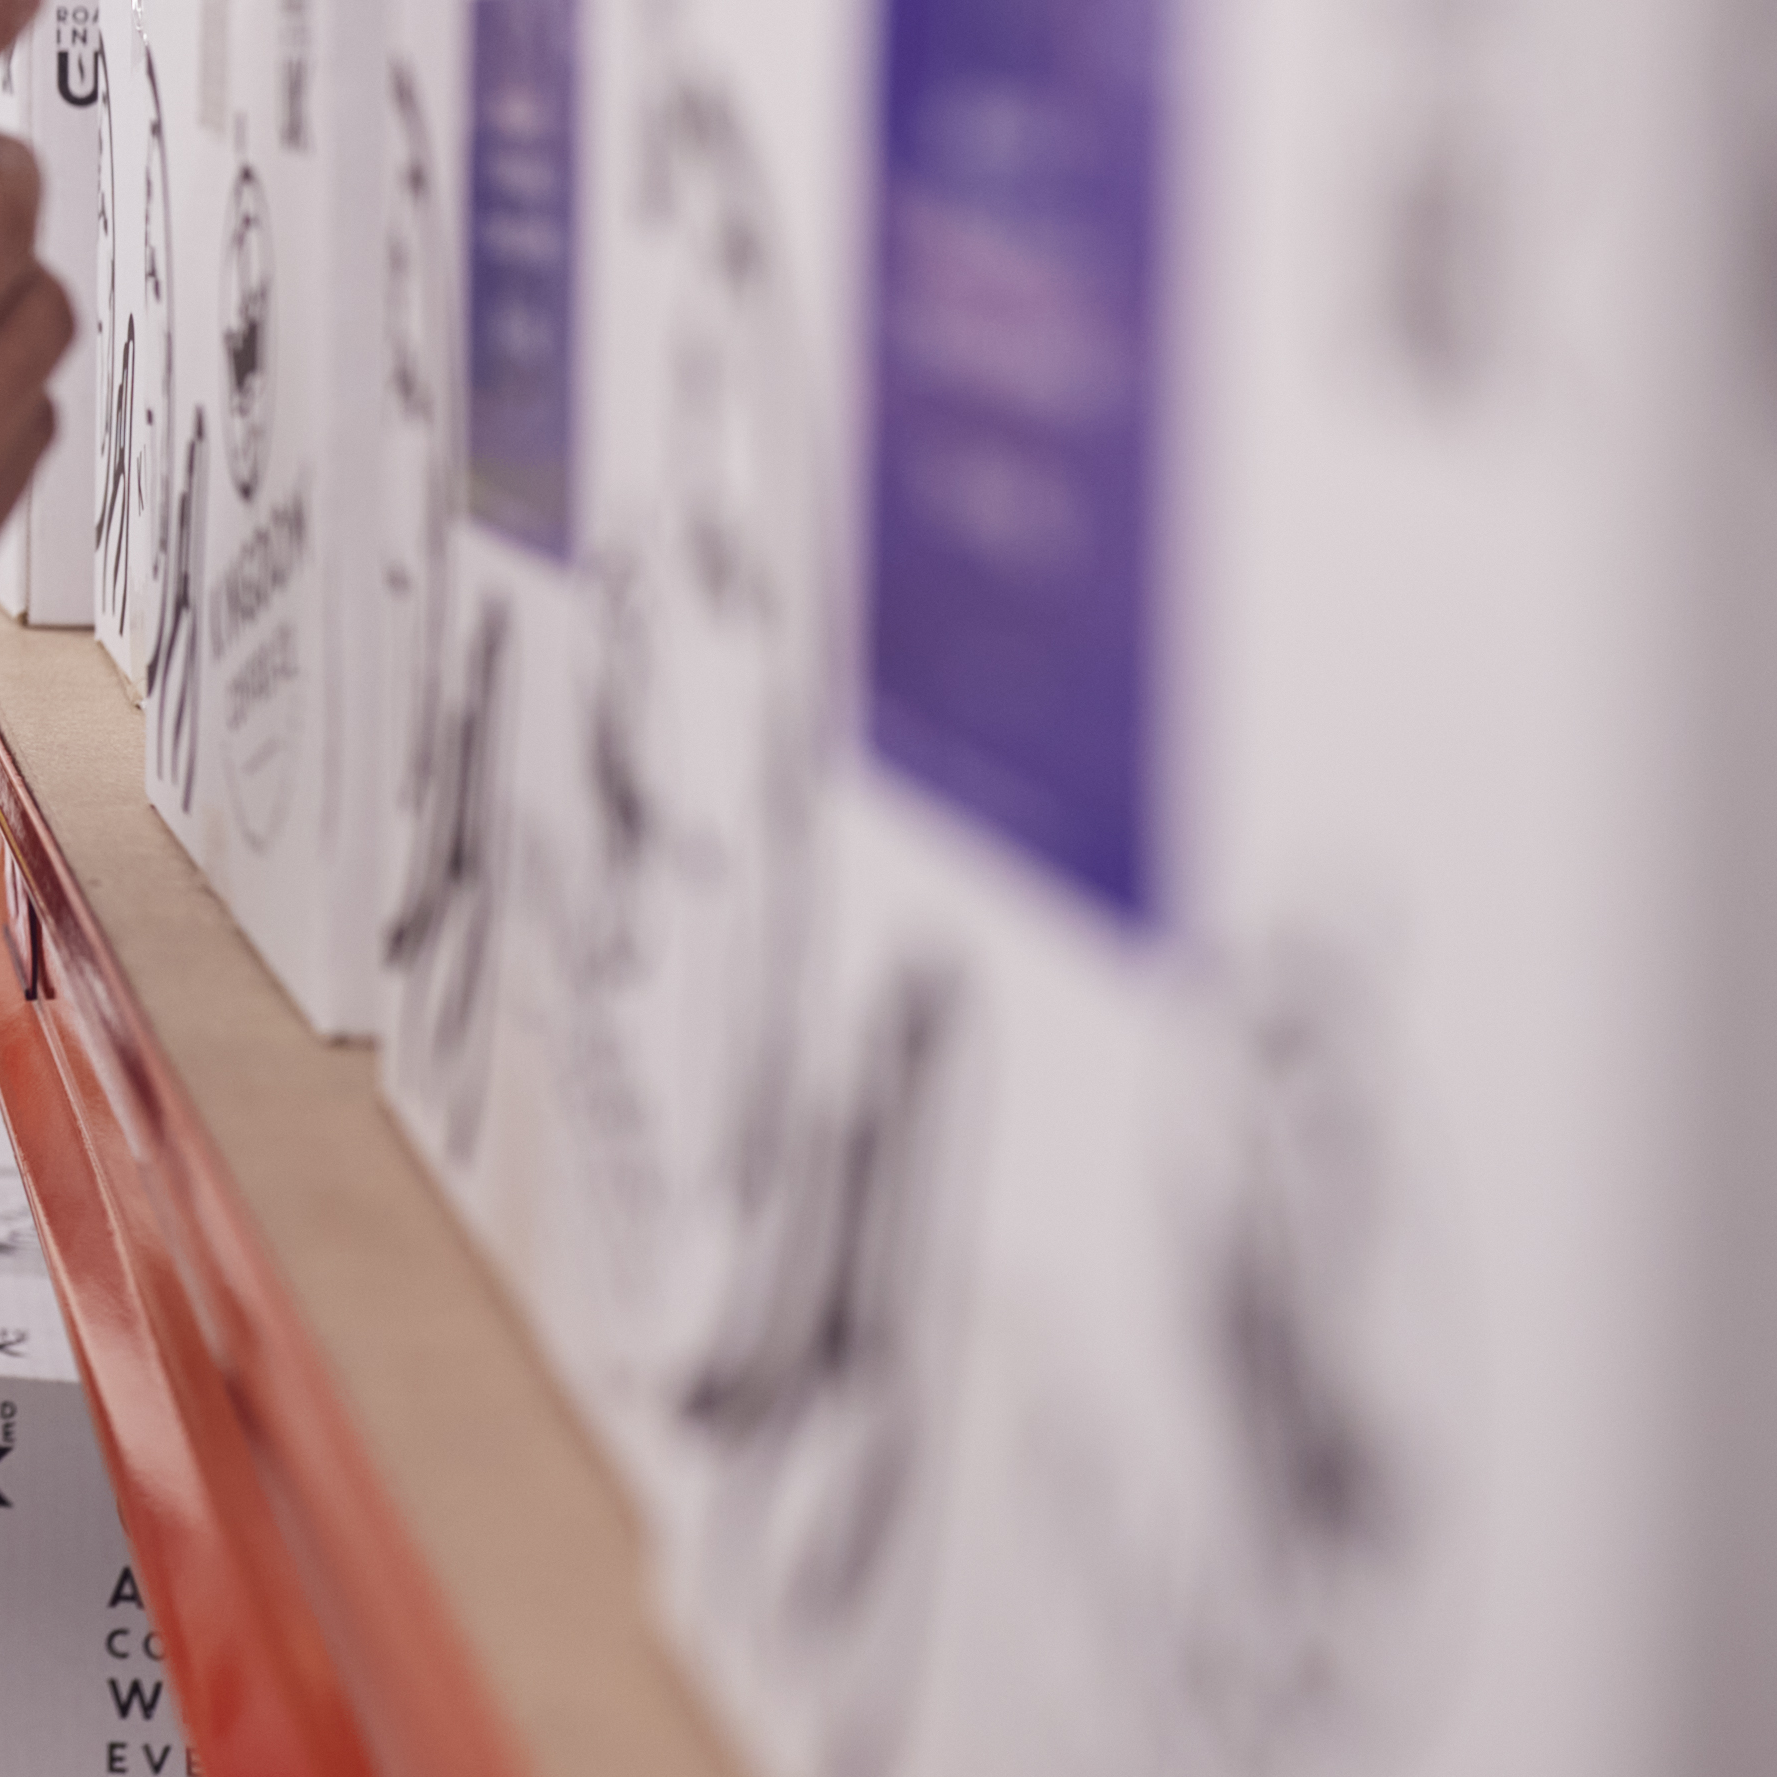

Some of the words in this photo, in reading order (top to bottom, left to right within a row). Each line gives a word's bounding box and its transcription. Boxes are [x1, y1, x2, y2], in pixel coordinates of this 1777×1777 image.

[56, 27, 88, 45] IN
[57, 50, 99, 107] U
[105, 1627, 166, 1662] CO
[107, 1677, 163, 1721] W
